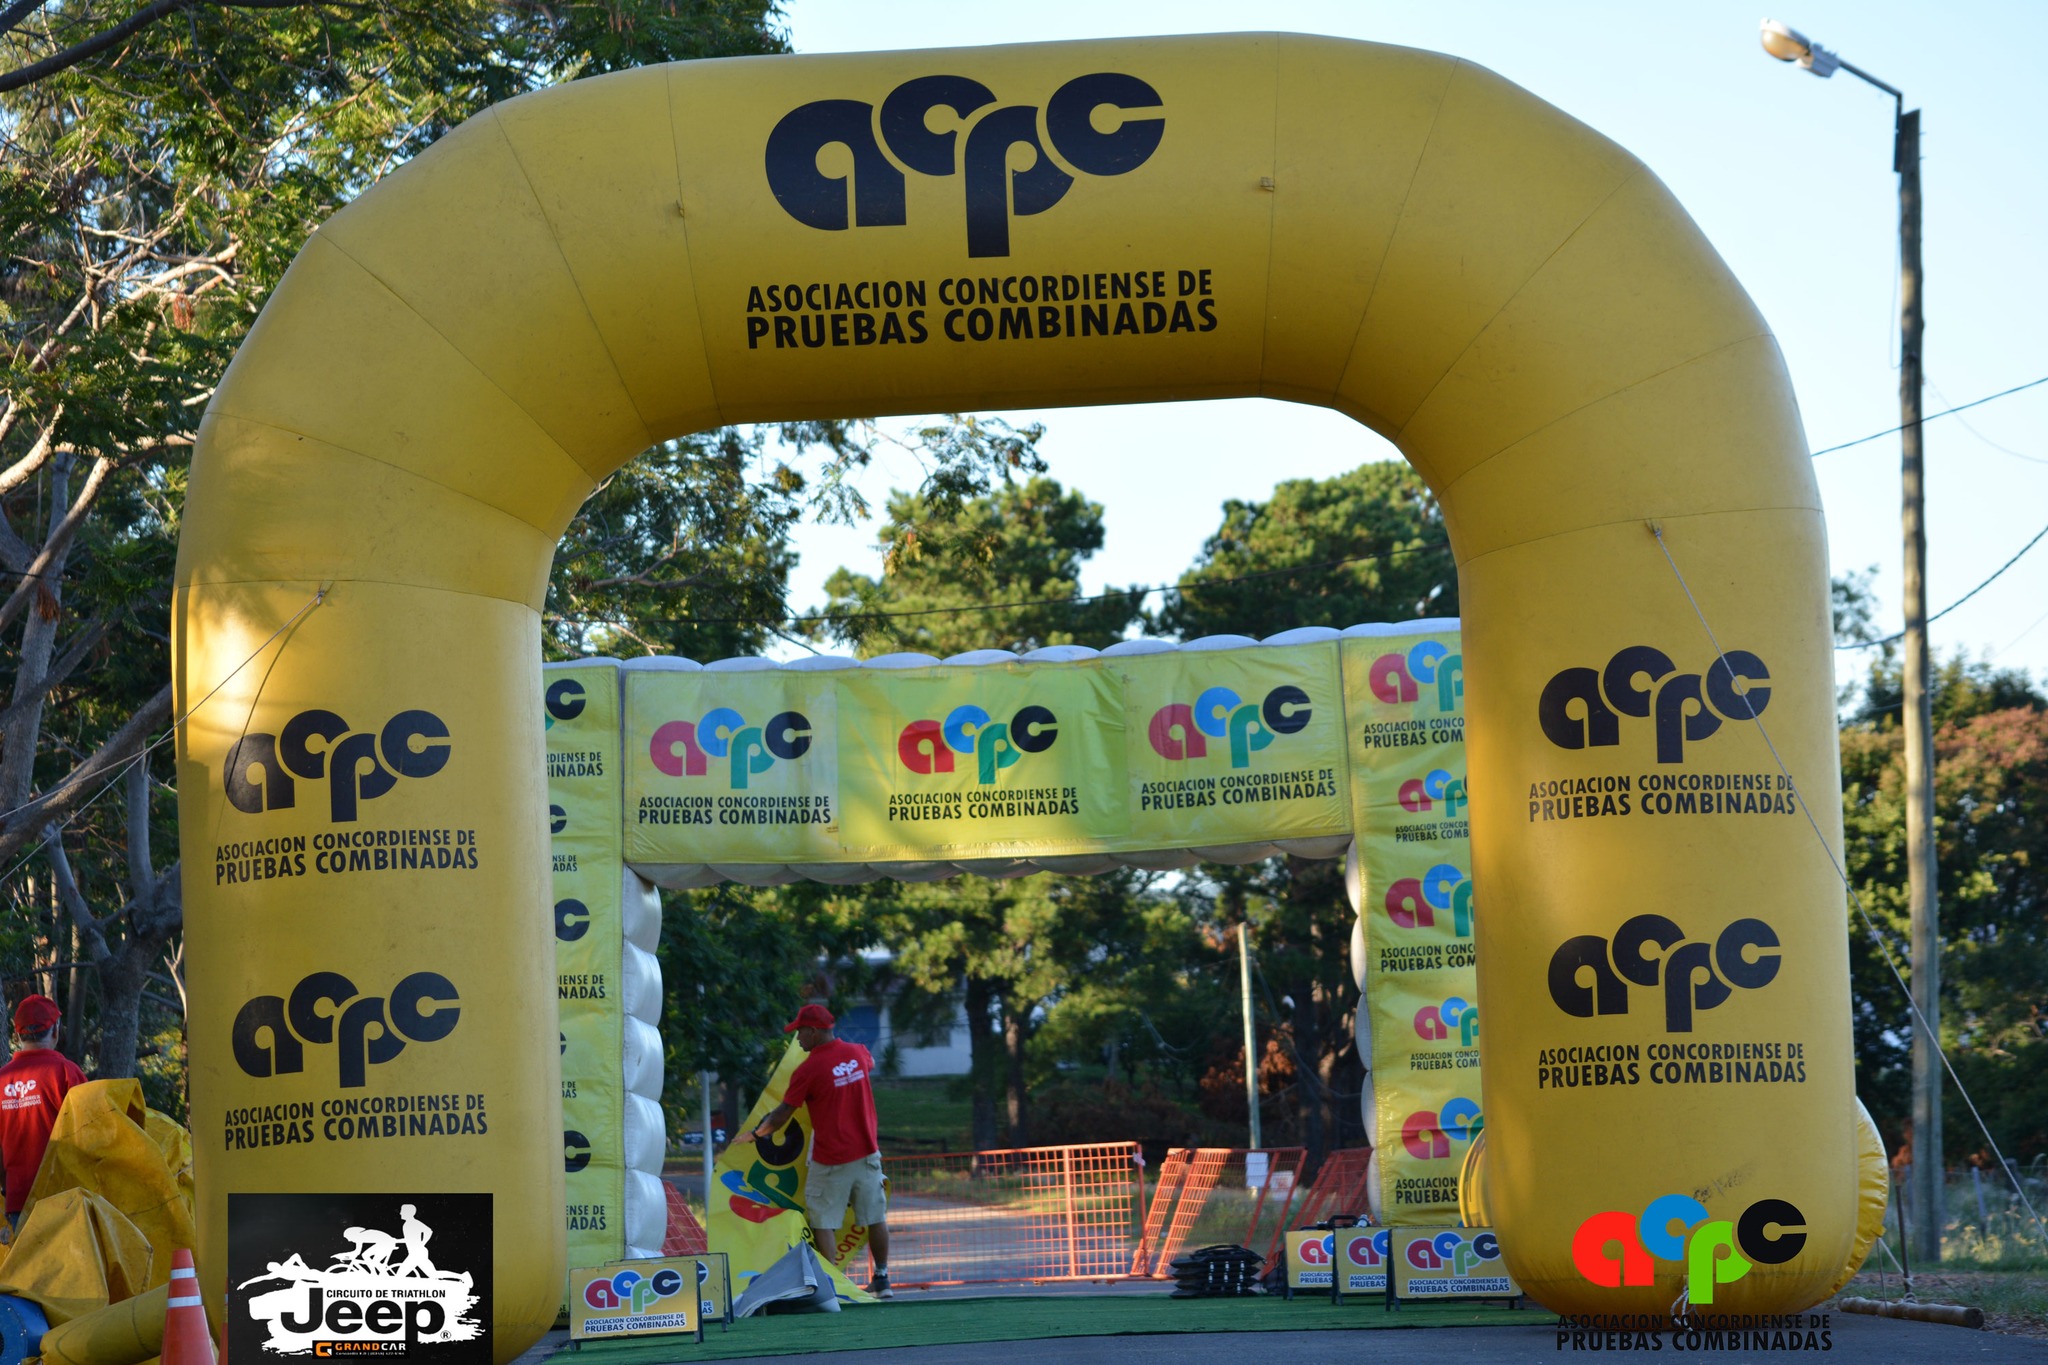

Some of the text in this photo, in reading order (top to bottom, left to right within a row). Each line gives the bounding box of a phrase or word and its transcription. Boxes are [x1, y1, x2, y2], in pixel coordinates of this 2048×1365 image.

[747, 269, 1213, 313] ASOCIACION CONCORDIENSE DE
[747, 300, 1218, 349] PRUEBAS COMBINADAS
[1364, 720, 1426, 734] ASOCIACION
[1365, 732, 1427, 749] PRUEBAS
[590, 752, 602, 762] DE
[1142, 768, 1333, 795] ASOCIACION CONCORDIENSE DE
[1529, 774, 1793, 799] ASOCIACION CONCORDIENSE DE
[889, 787, 1077, 805] ASOCIACION CONCORDIENSE DE
[1142, 781, 1336, 811] PRUEBAS COMBINADAS
[1398, 769, 1468, 817] acp
[639, 796, 829, 808] ASOCIACION CONCORDIENSE DE
[889, 799, 1079, 821] PRUEBAS COMBINADAS
[1529, 792, 1796, 823] PRUEBAS COMBINADAS
[639, 808, 831, 824] PRUEBAS COMBINADAS
[1396, 823, 1437, 833] ASOCIACION
[1396, 831, 1437, 842] PRUEBAS
[216, 830, 476, 862] ASOCIACION CONCORDIENSE DE
[216, 848, 479, 886] PRUEBAS COMBINADAS
[1381, 946, 1442, 958] ASOCIACION
[1381, 956, 1442, 972] PRUEBAS
[592, 974, 604, 984] DE
[1410, 1052, 1453, 1060] ASOCIACION
[1539, 1043, 1803, 1066] ASOCIACION CONCORDIENSE DE
[1410, 1060, 1453, 1070] PRUEBAS
[1539, 1061, 1806, 1089] PRUEBAS COMBINADAS
[225, 1094, 485, 1127] ASOCIACION CONCORDIENSE DE
[225, 1112, 488, 1151] PRUEBAS COMBINADAS
[1396, 1177, 1458, 1189] ASOCIACION
[1396, 1188, 1459, 1204] PRUEBAS
[593, 1205, 605, 1215] DE
[1300, 1276, 1333, 1284] PRUEBAS
[1350, 1280, 1386, 1288] PRUEBAS
[1409, 1283, 1510, 1293] PRUEBAS COMBINADAS
[585, 1318, 624, 1326] ASOCIACION
[626, 1314, 674, 1322] CONCORDIENSE
[585, 1319, 685, 1333] PRUEBAS COMBINADAS
